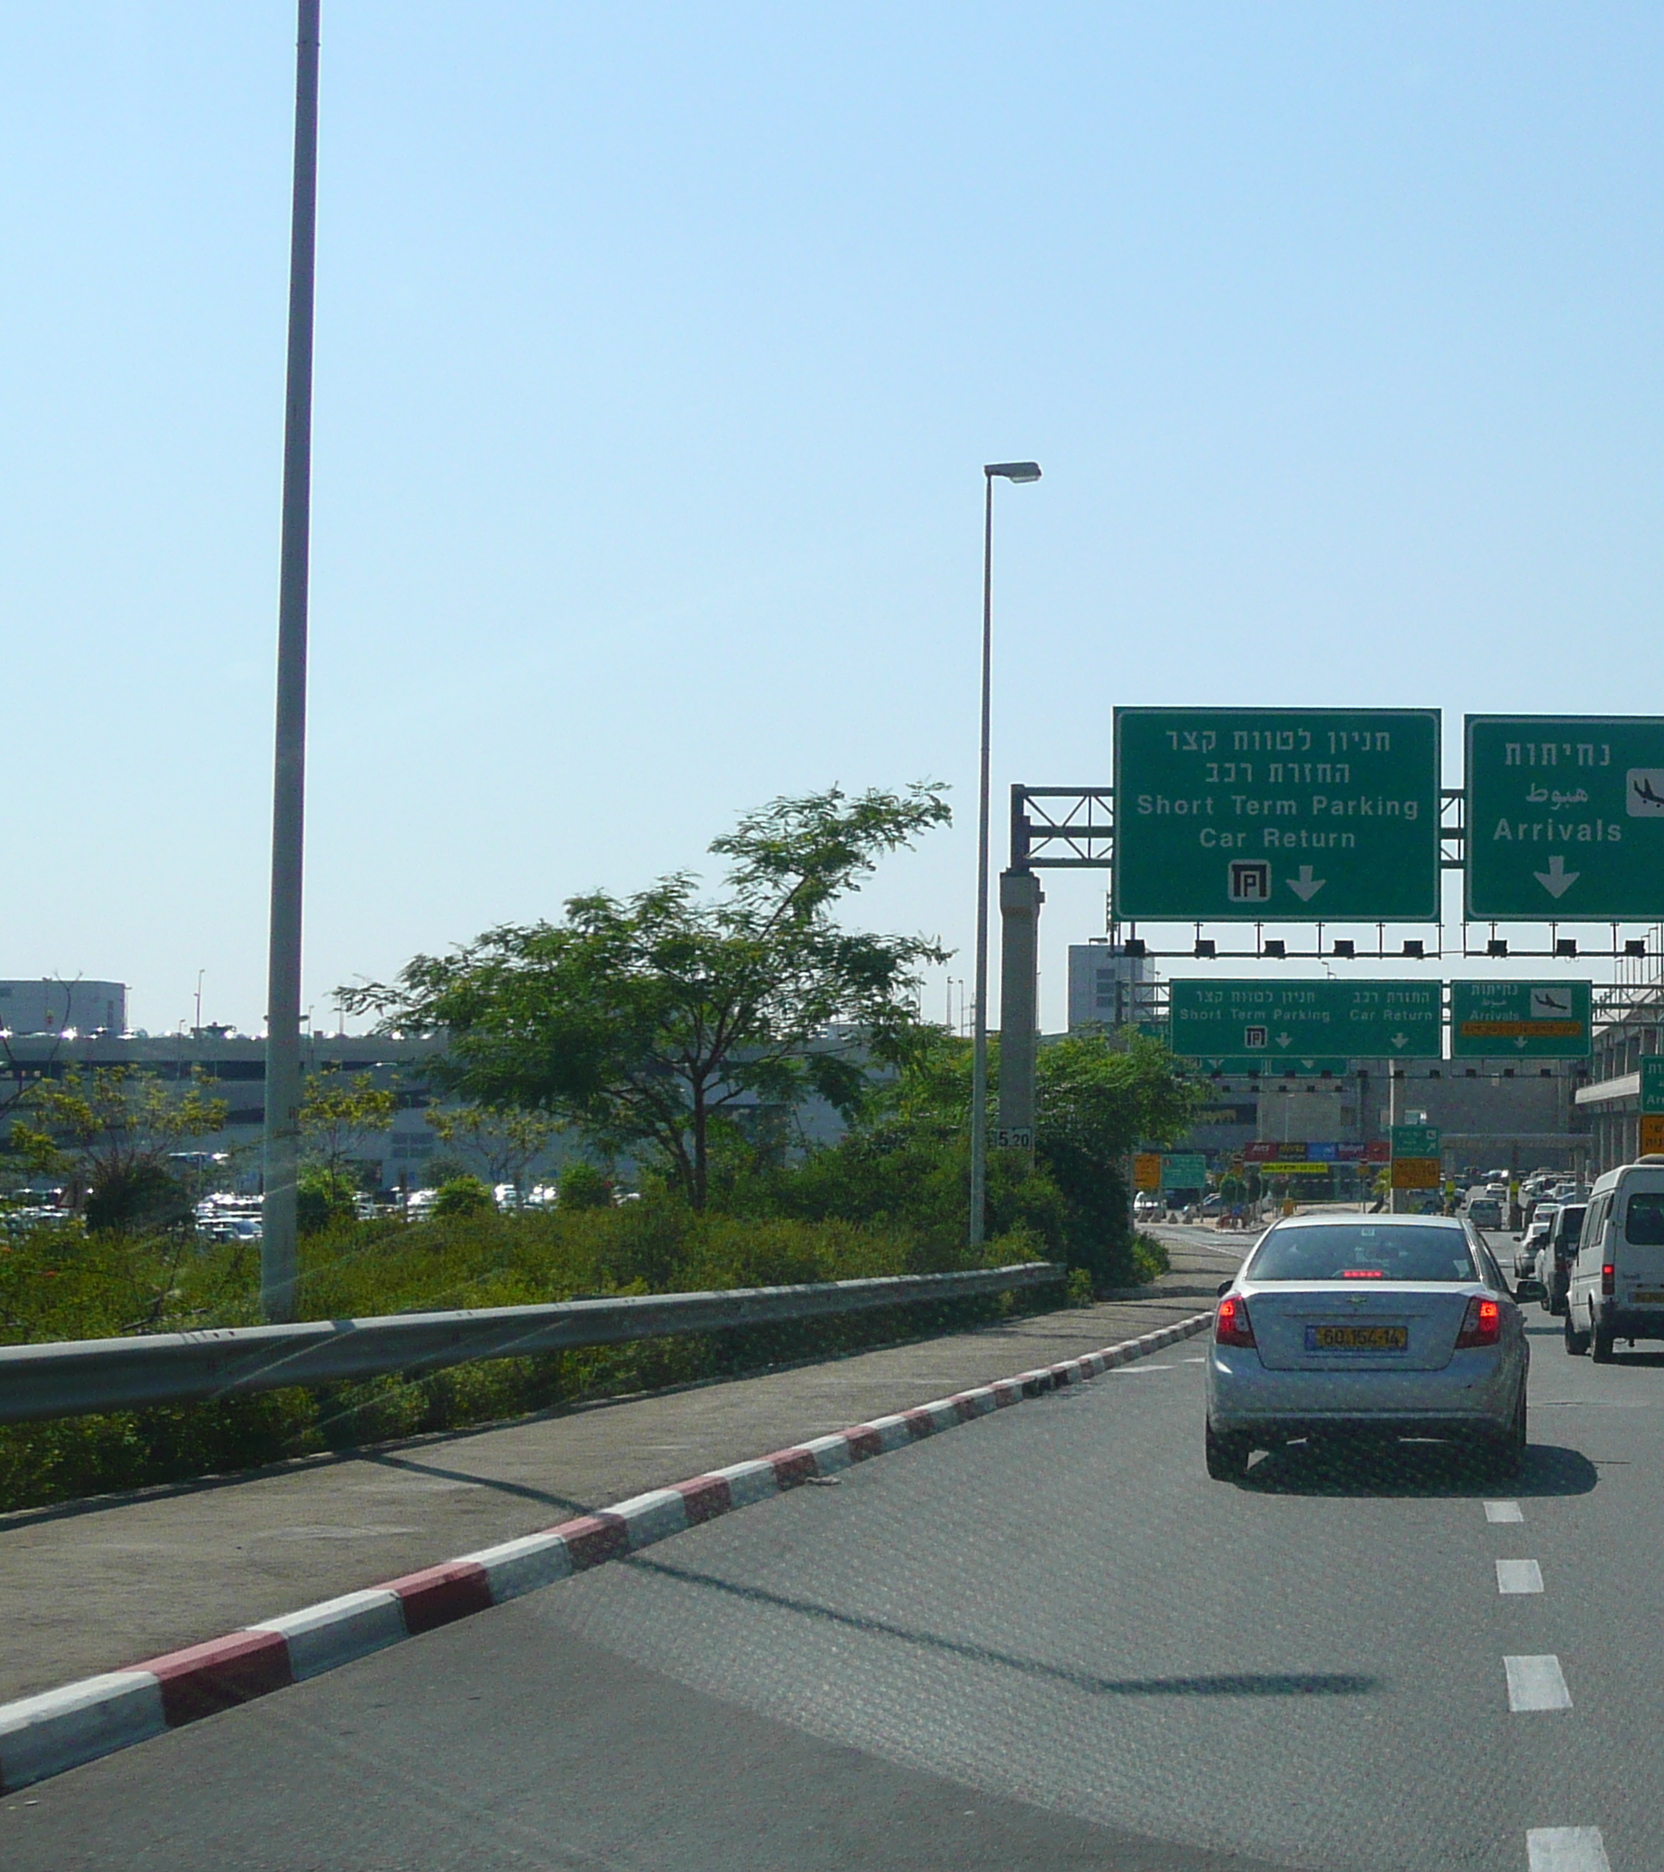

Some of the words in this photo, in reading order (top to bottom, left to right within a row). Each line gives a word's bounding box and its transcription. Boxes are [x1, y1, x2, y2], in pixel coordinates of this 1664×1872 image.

[1166, 731, 1217, 754] קצר
[1233, 728, 1311, 751] לטווח
[1327, 731, 1391, 755] חניון
[1505, 743, 1611, 767] נחיתות
[1205, 763, 1253, 783] רכב
[1268, 763, 1351, 784] החזרת
[1136, 795, 1214, 816] Short
[1231, 796, 1297, 816] Term
[1312, 796, 1419, 820] Parking
[1526, 782, 1589, 811] هبوط
[1199, 828, 1247, 848] Car
[1263, 828, 1356, 848] Return
[1493, 818, 1622, 842] Arrivals
[1180, 1009, 1222, 1021] Short
[1231, 1009, 1266, 1021] Term
[1273, 1009, 1331, 1023] Parking
[1350, 1010, 1376, 1021] Car
[1384, 1010, 1433, 1021] Return
[1469, 1009, 1520, 1021] Arrivals
